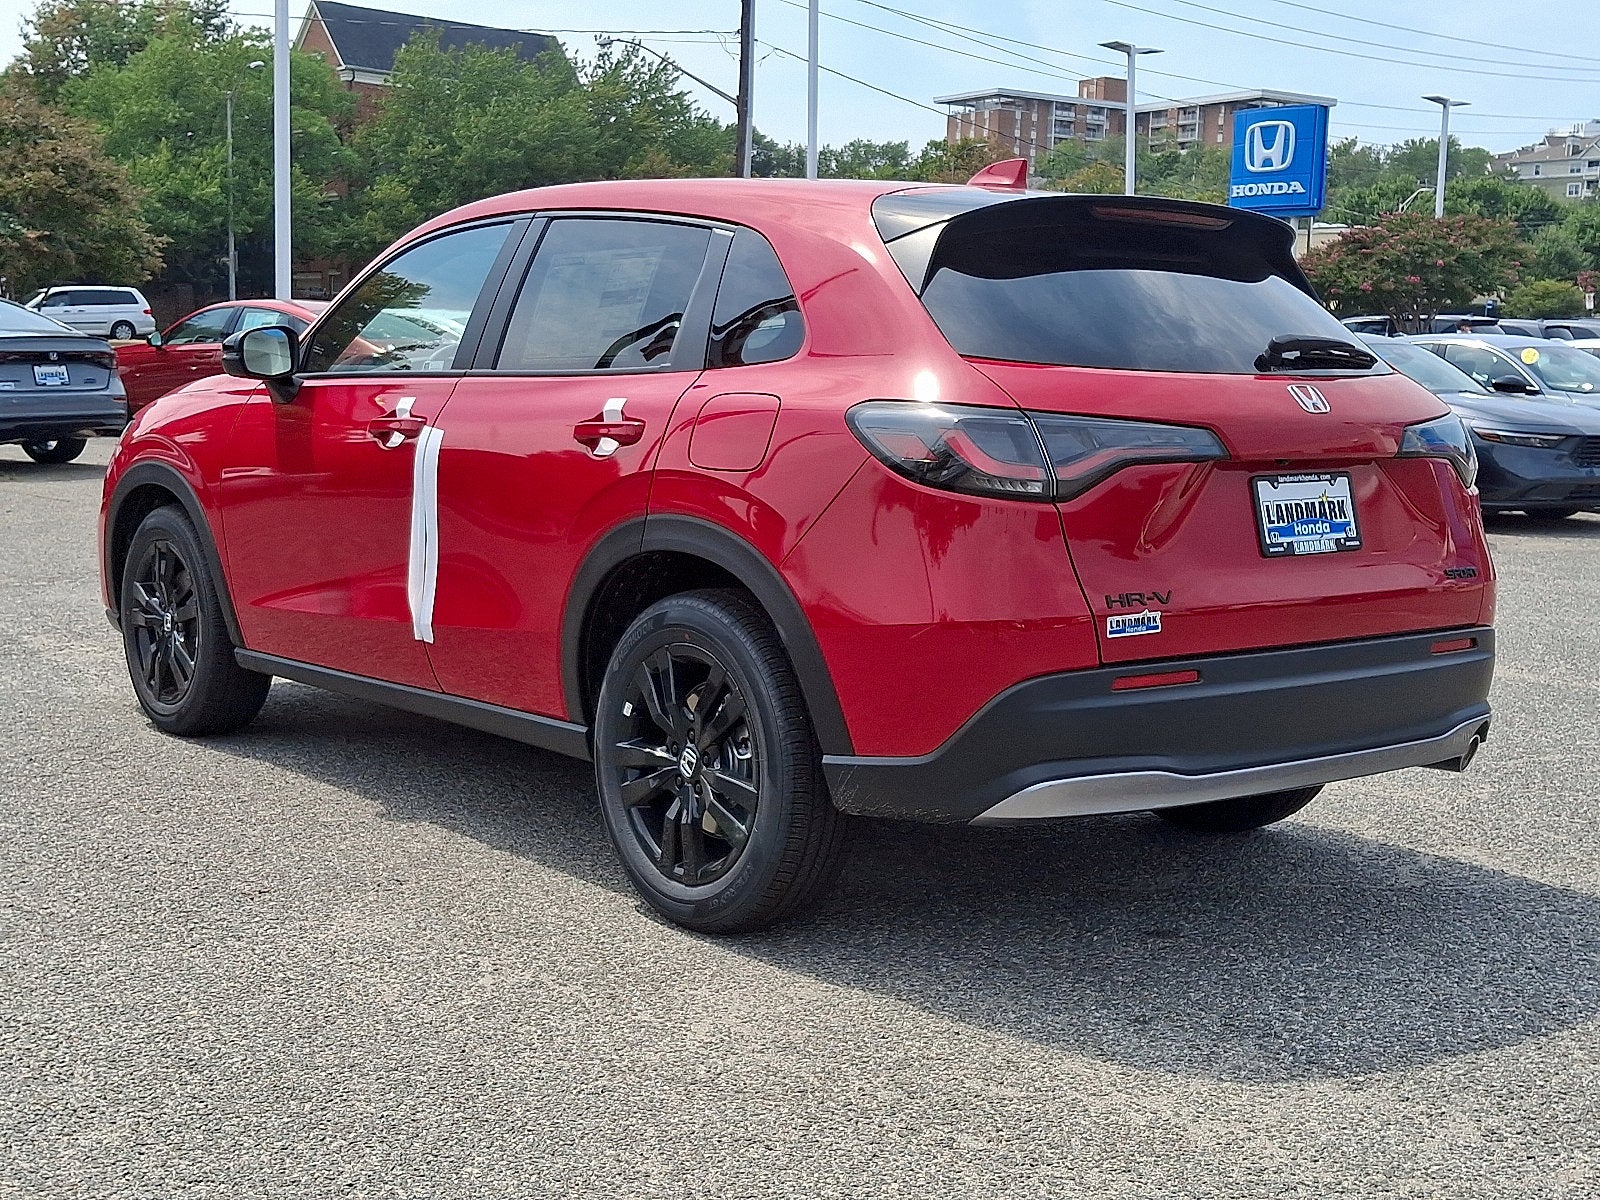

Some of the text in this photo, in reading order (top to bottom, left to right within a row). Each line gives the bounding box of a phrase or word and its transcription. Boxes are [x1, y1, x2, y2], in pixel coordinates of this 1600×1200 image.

[1231, 181, 1306, 198] HONDA
[1265, 499, 1348, 525] LANDMARK
[1294, 520, 1331, 536] Honda
[1293, 539, 1338, 553] LANDMARK
[1104, 590, 1173, 609] HR-V
[1109, 615, 1158, 629] LANDMARK
[1125, 625, 1147, 633] Honda
